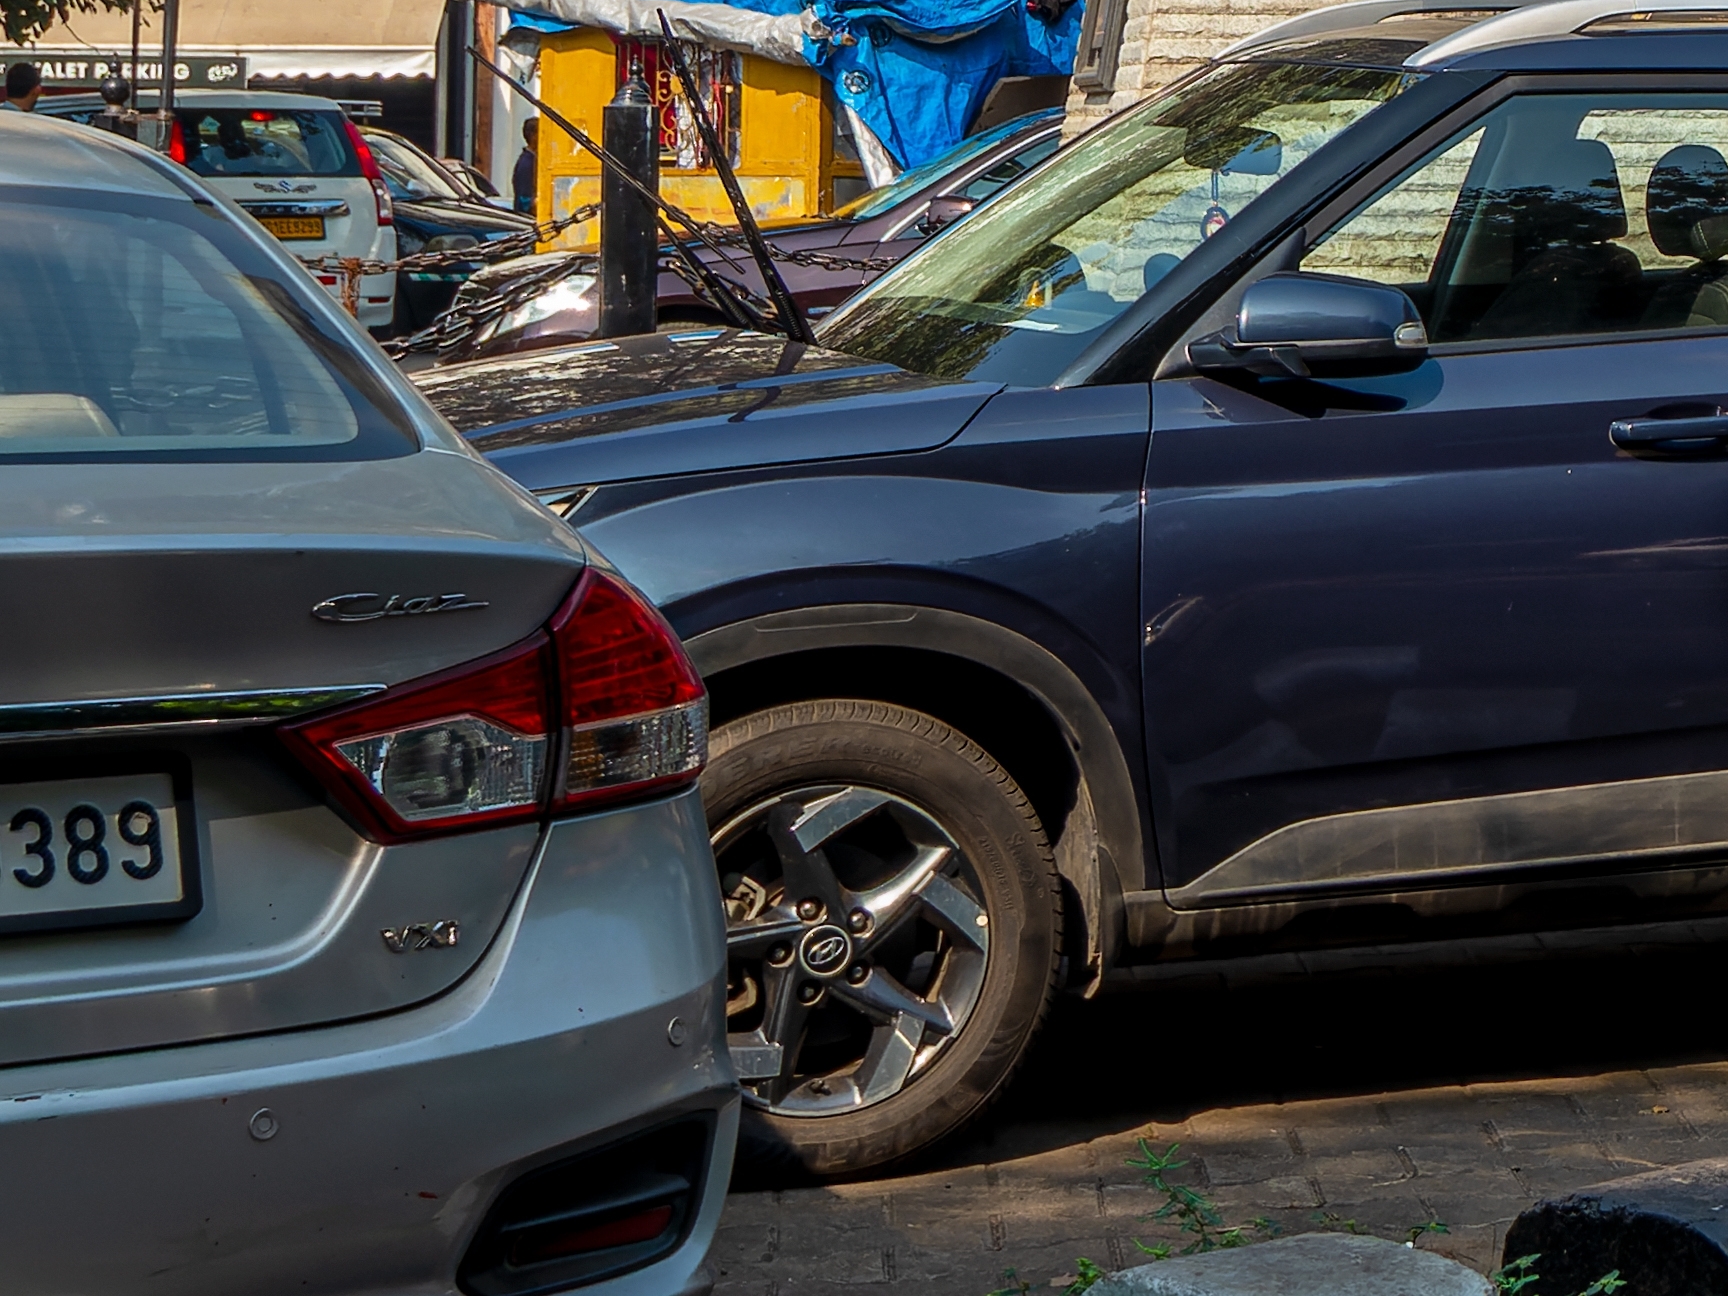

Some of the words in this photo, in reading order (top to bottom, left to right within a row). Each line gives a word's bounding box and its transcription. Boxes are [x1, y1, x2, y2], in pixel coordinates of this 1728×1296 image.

[34, 61, 88, 79] ALET
[94, 61, 190, 80] PRKIG
[312, 593, 489, 621] Ciaz
[0, 800, 164, 888] 389
